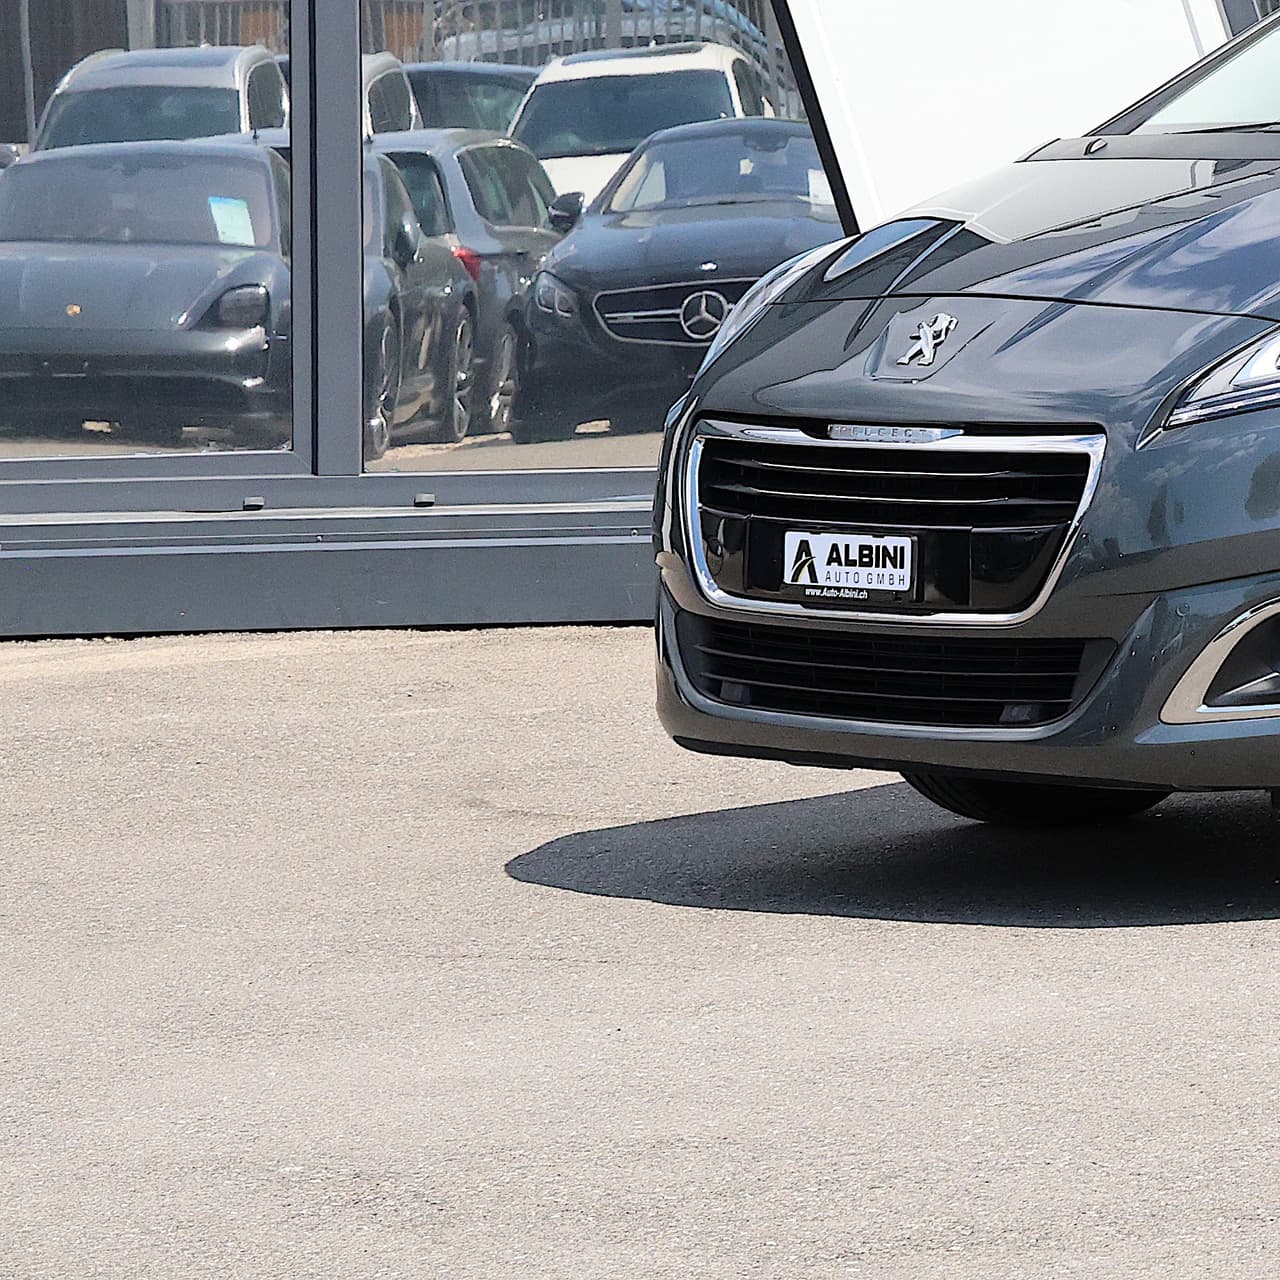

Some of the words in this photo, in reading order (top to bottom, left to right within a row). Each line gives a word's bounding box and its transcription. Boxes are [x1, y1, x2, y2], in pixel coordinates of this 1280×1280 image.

[825, 543, 905, 570] ALBINI
[824, 571, 860, 584] AUTO
[866, 572, 905, 586] GMBH
[805, 587, 868, 599] www.Auto-Albini.ch
